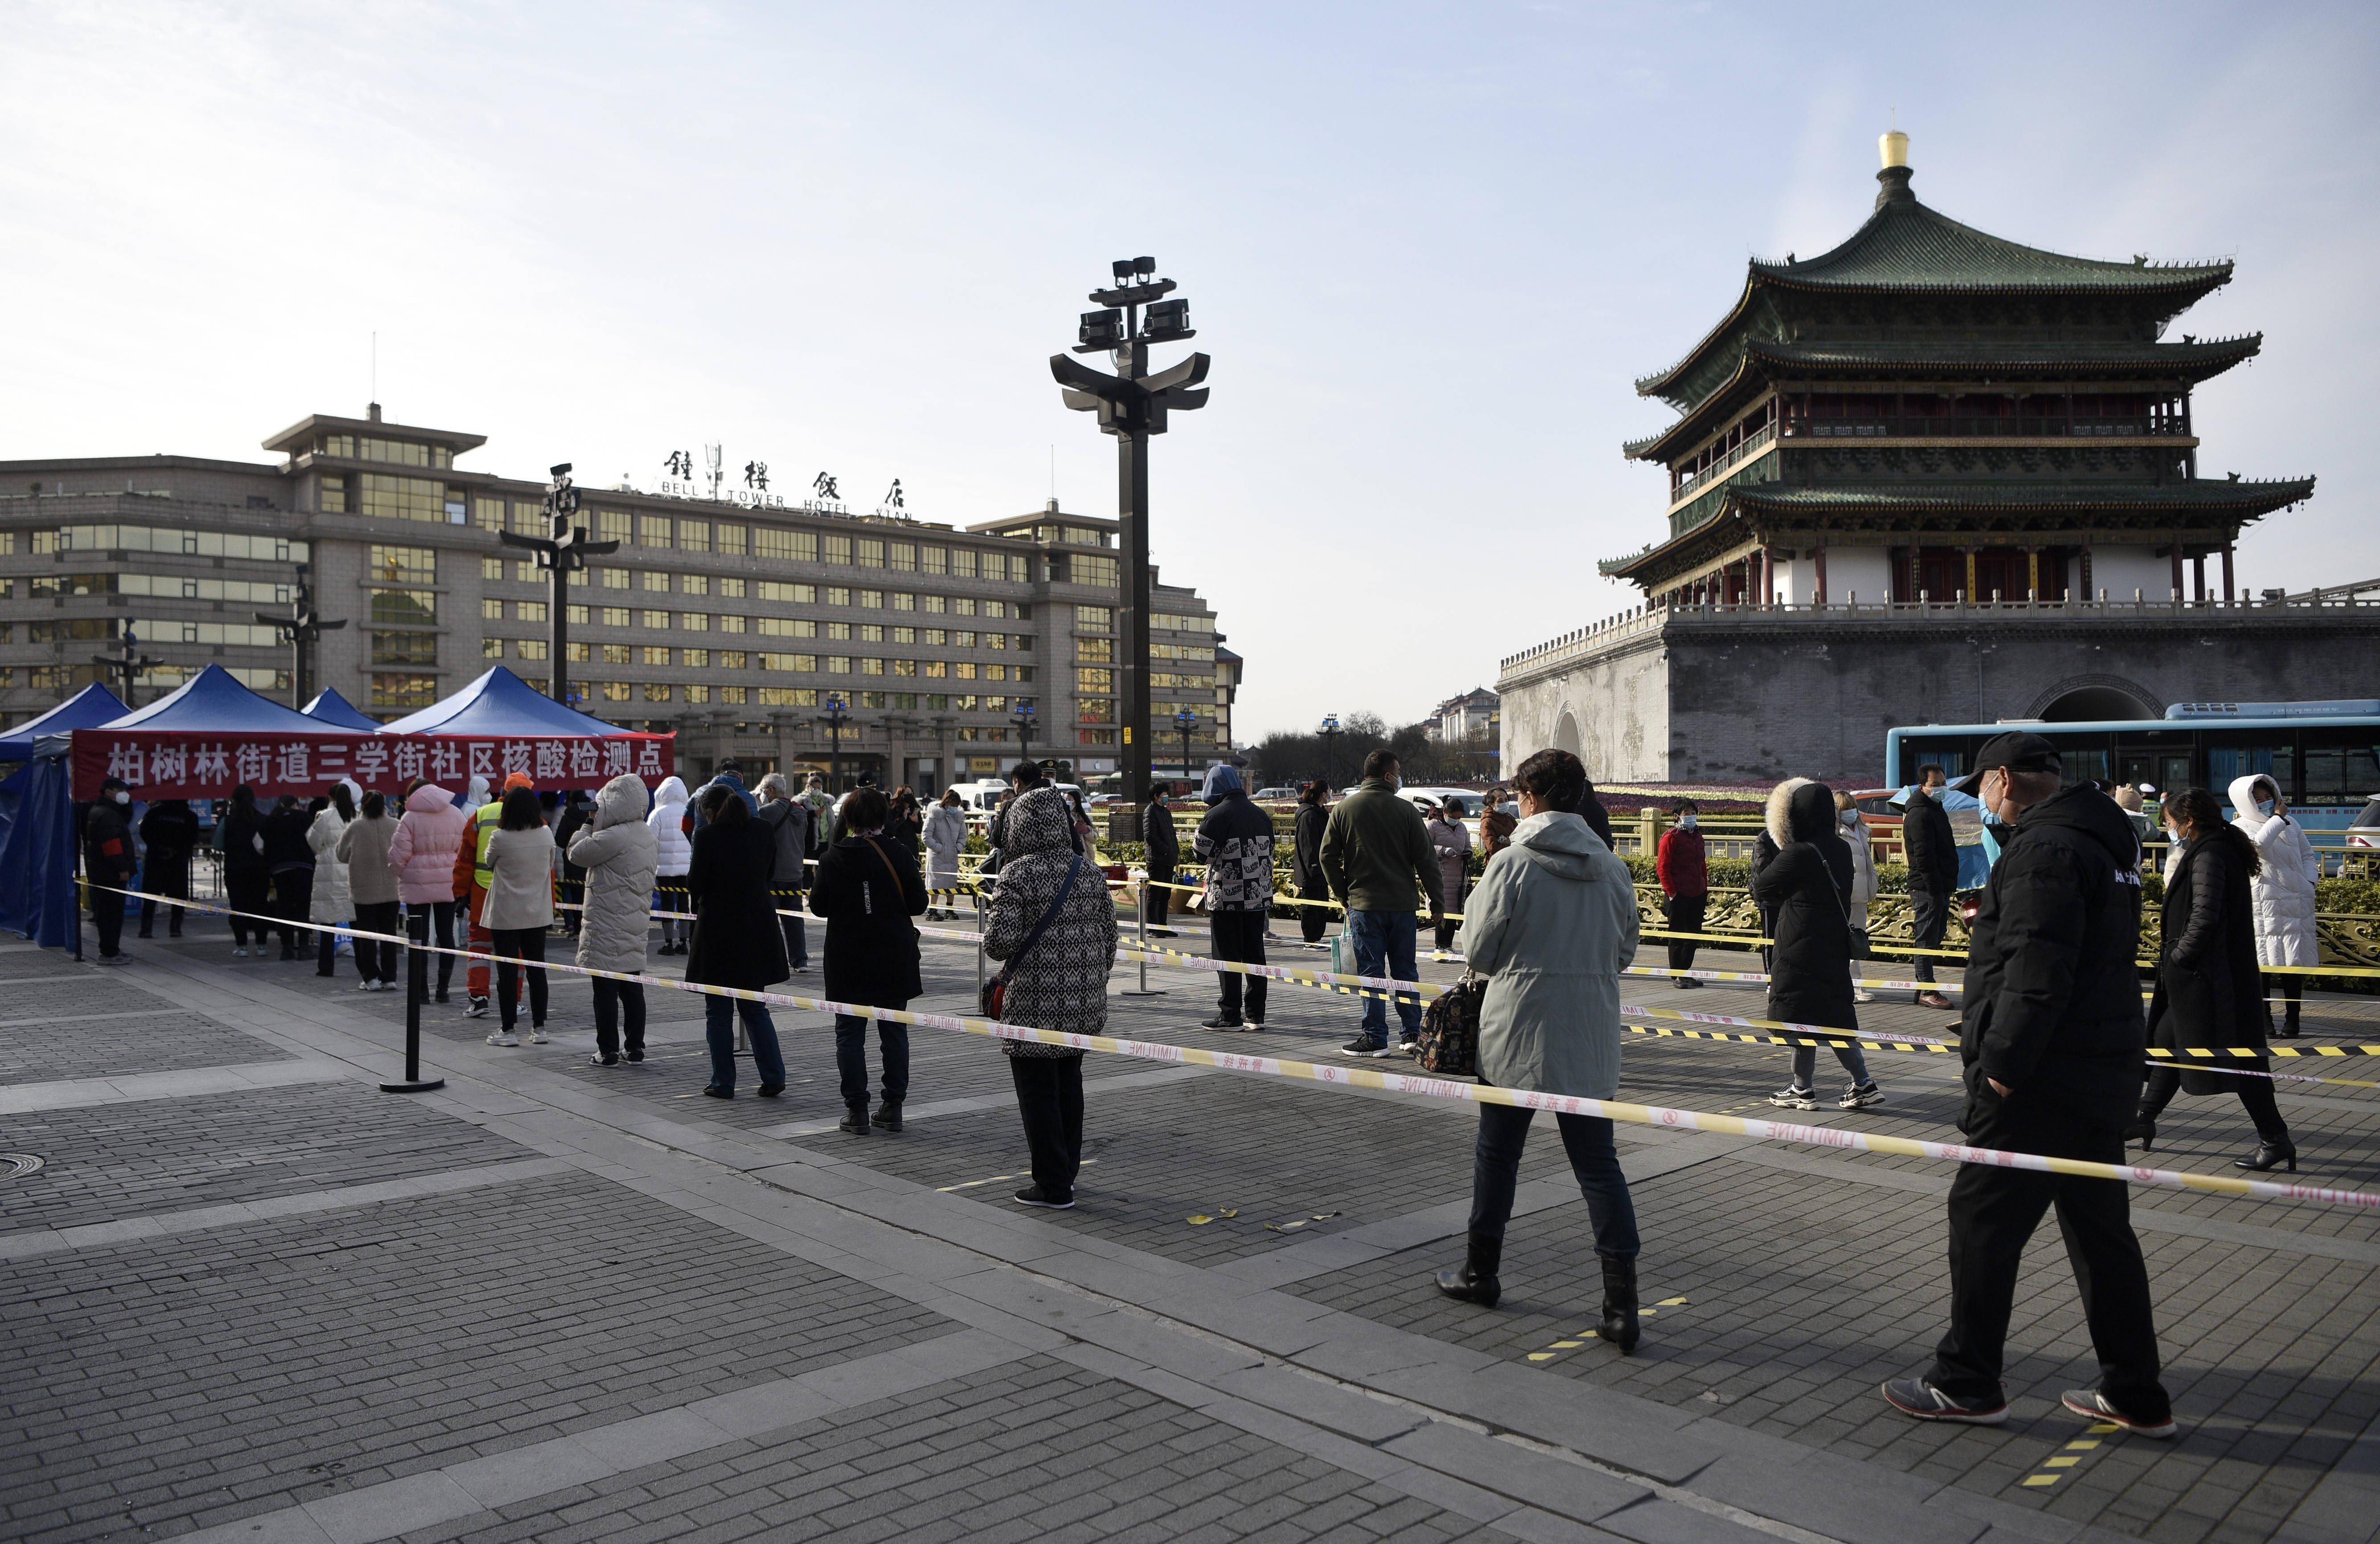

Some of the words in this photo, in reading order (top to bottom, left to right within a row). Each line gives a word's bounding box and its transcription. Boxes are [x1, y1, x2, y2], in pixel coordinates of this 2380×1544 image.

[662, 482, 698, 496] BELL
[728, 490, 783, 506] TOWER
[804, 500, 847, 514] HOTEL
[107, 740, 663, 785] 柏树林街道三学街社区核酸检测点
